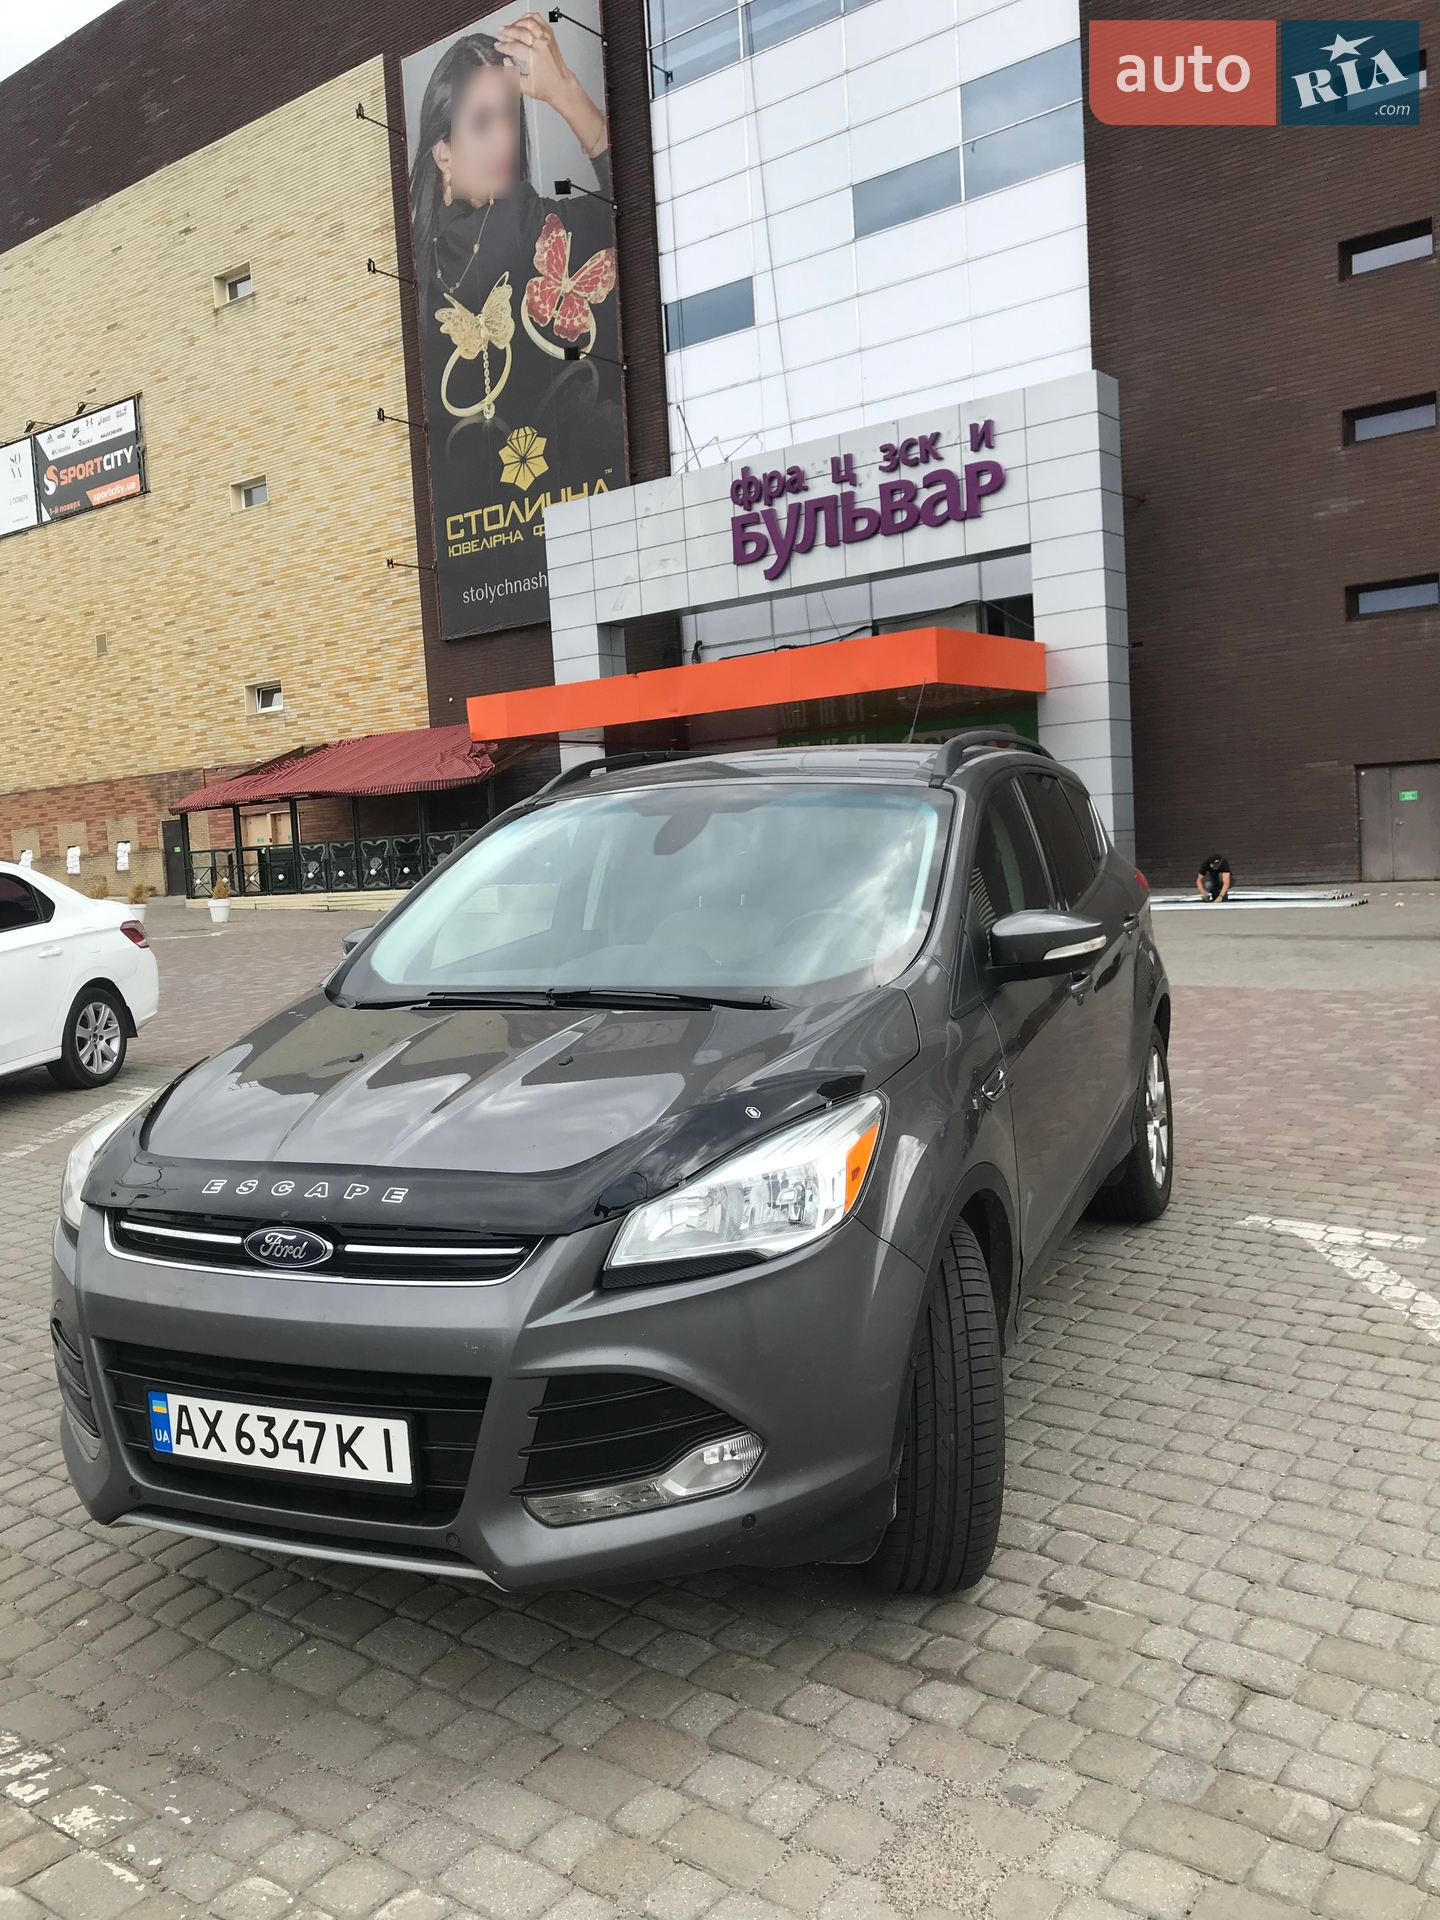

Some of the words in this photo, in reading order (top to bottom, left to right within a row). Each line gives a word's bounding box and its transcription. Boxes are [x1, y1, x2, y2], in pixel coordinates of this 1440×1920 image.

[60, 445, 134, 486] SPORTCITY
[92, 481, 136, 503] sportcity.ua
[448, 529, 524, 558] ЮВЕЛІРНА
[201, 1179, 409, 1204] ESCAPE
[259, 1231, 308, 1261] Ford
[154, 1429, 170, 1443] UA
